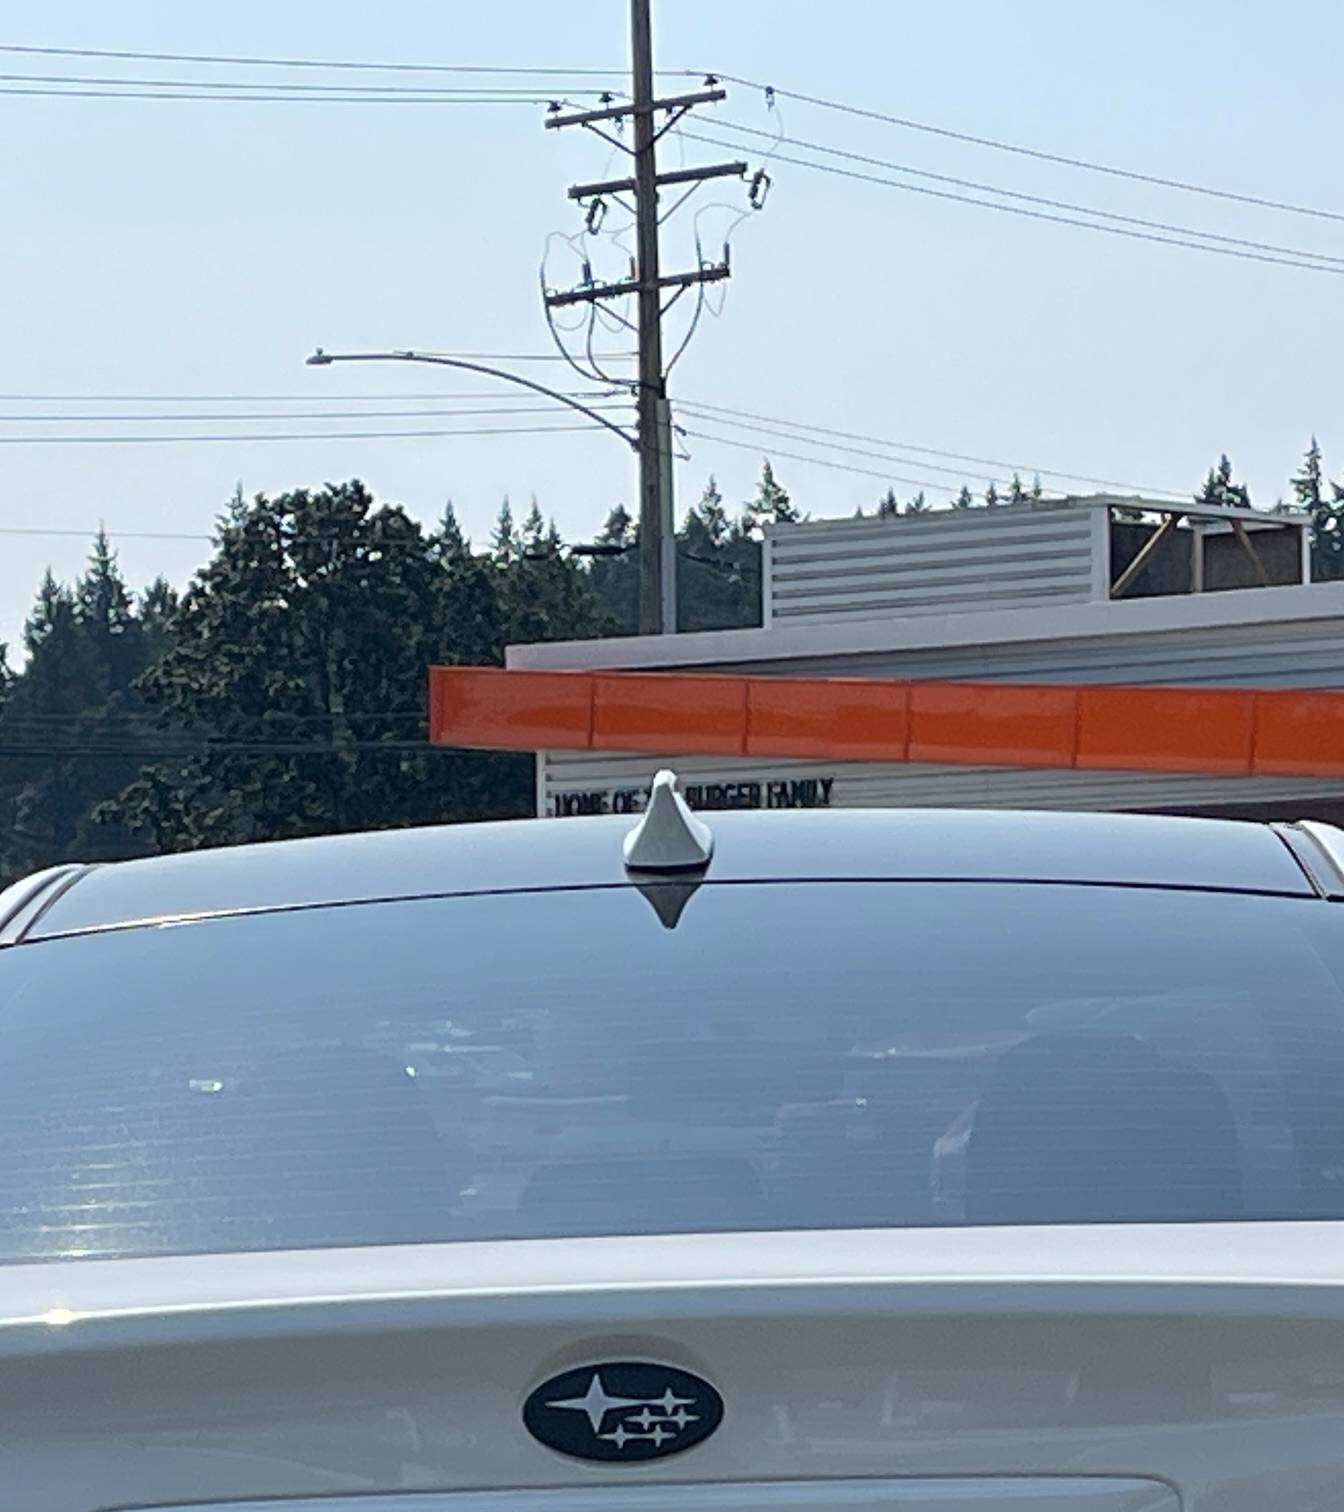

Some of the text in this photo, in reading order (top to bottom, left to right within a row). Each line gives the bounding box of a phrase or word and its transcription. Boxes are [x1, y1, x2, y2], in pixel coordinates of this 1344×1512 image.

[555, 791, 607, 816] HOME
[613, 789, 642, 814] OF
[687, 783, 760, 810] BURGER
[767, 778, 835, 808] FAMILY
